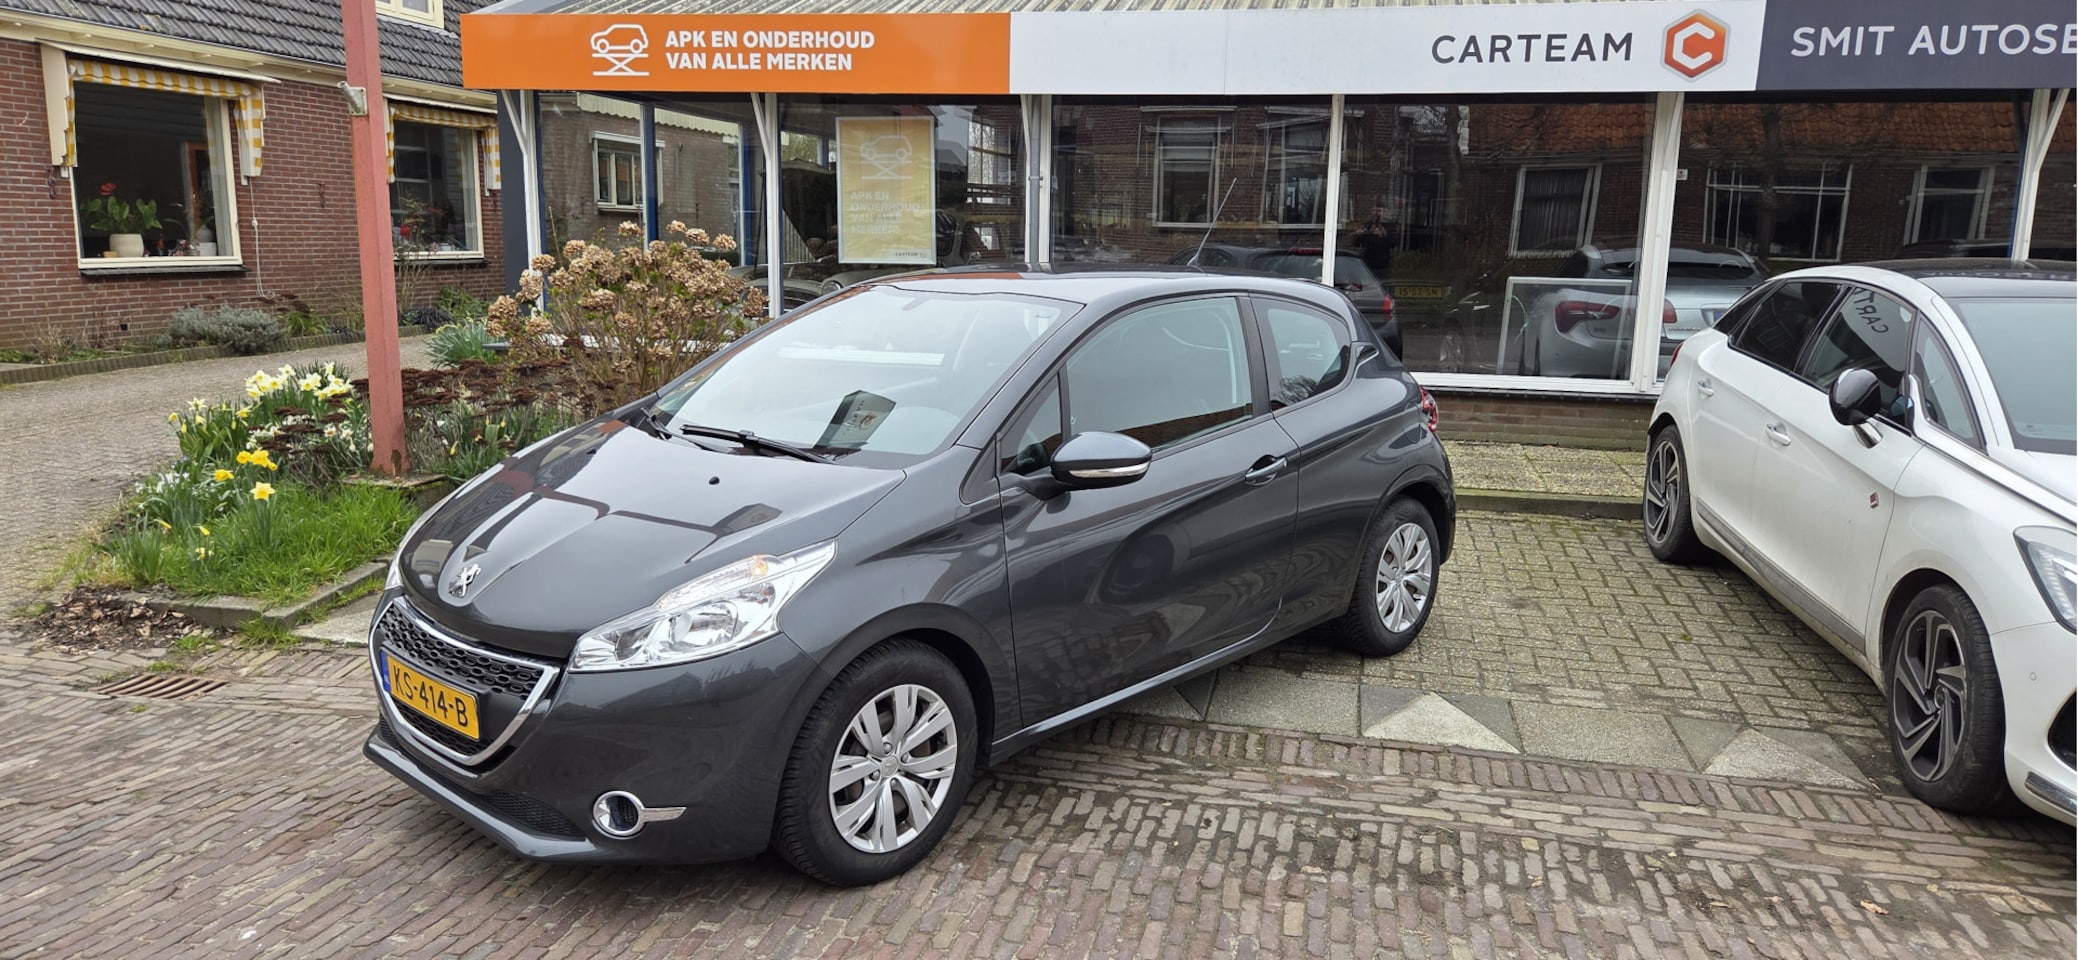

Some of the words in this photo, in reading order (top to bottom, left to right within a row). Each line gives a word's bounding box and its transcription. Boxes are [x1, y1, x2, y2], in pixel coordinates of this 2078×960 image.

[665, 30, 706, 48] APK
[711, 31, 738, 48] EN
[743, 31, 875, 49] ONDERHOUD
[1431, 32, 1633, 64] CARTEAM
[1791, 26, 1895, 57] SMIT
[1908, 23, 2077, 55] AUTOSE
[665, 52, 707, 69] VAN
[711, 53, 762, 70] ALLE
[766, 53, 853, 71] MERKEN
[850, 191, 873, 200] APK
[875, 191, 890, 200] EN
[850, 213, 873, 223] VAN
[393, 665, 468, 728] KS-414-B
